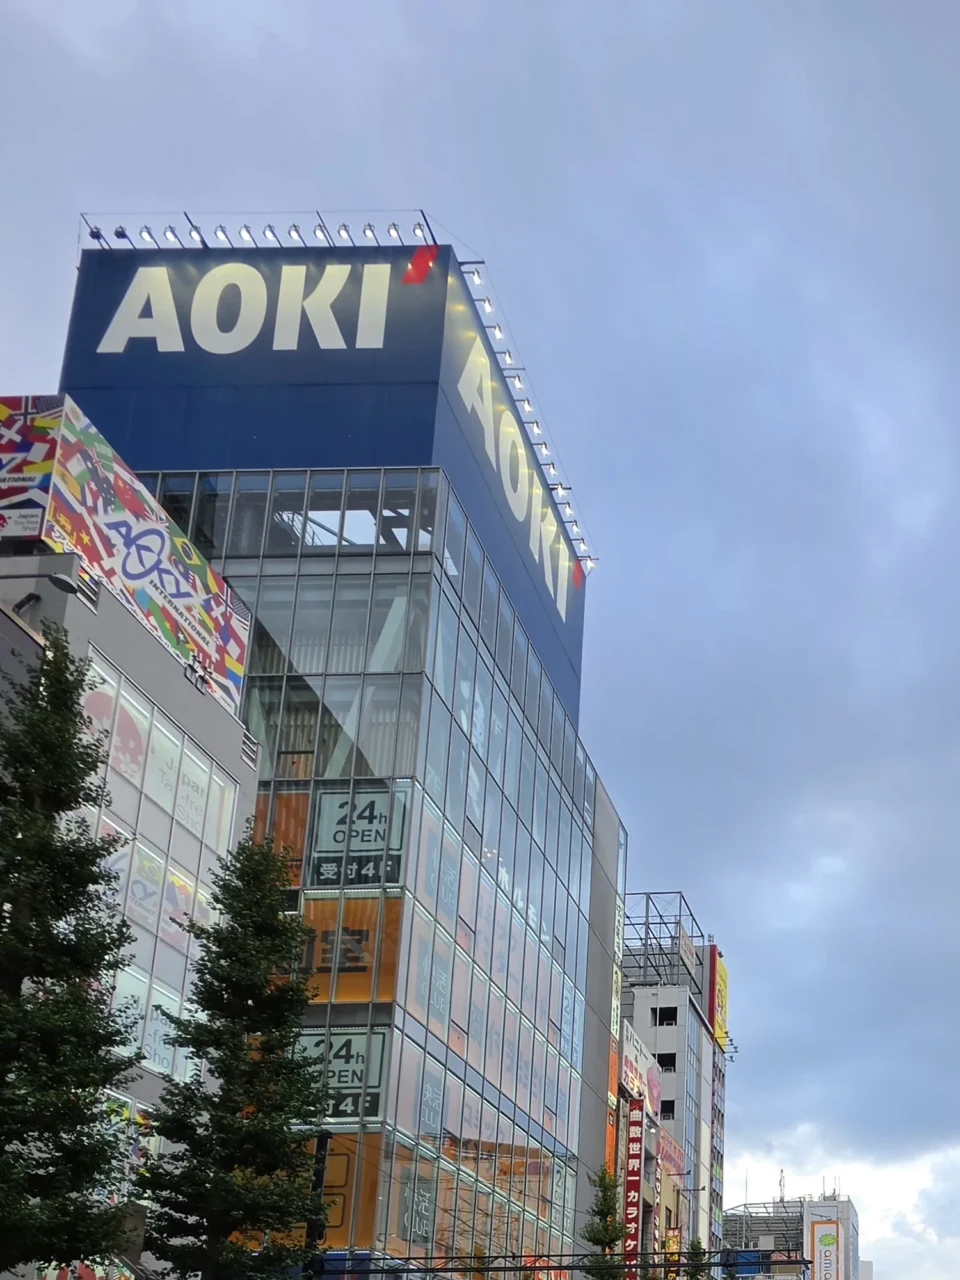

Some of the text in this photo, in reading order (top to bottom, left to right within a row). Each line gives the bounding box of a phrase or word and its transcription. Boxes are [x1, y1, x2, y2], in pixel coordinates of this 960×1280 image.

[96, 263, 391, 355] AOKI
[457, 335, 566, 623] AOKI
[149, 579, 211, 648] INTERNATIONAL
[332, 828, 387, 844] OPEN
[336, 800, 388, 826] 24h
